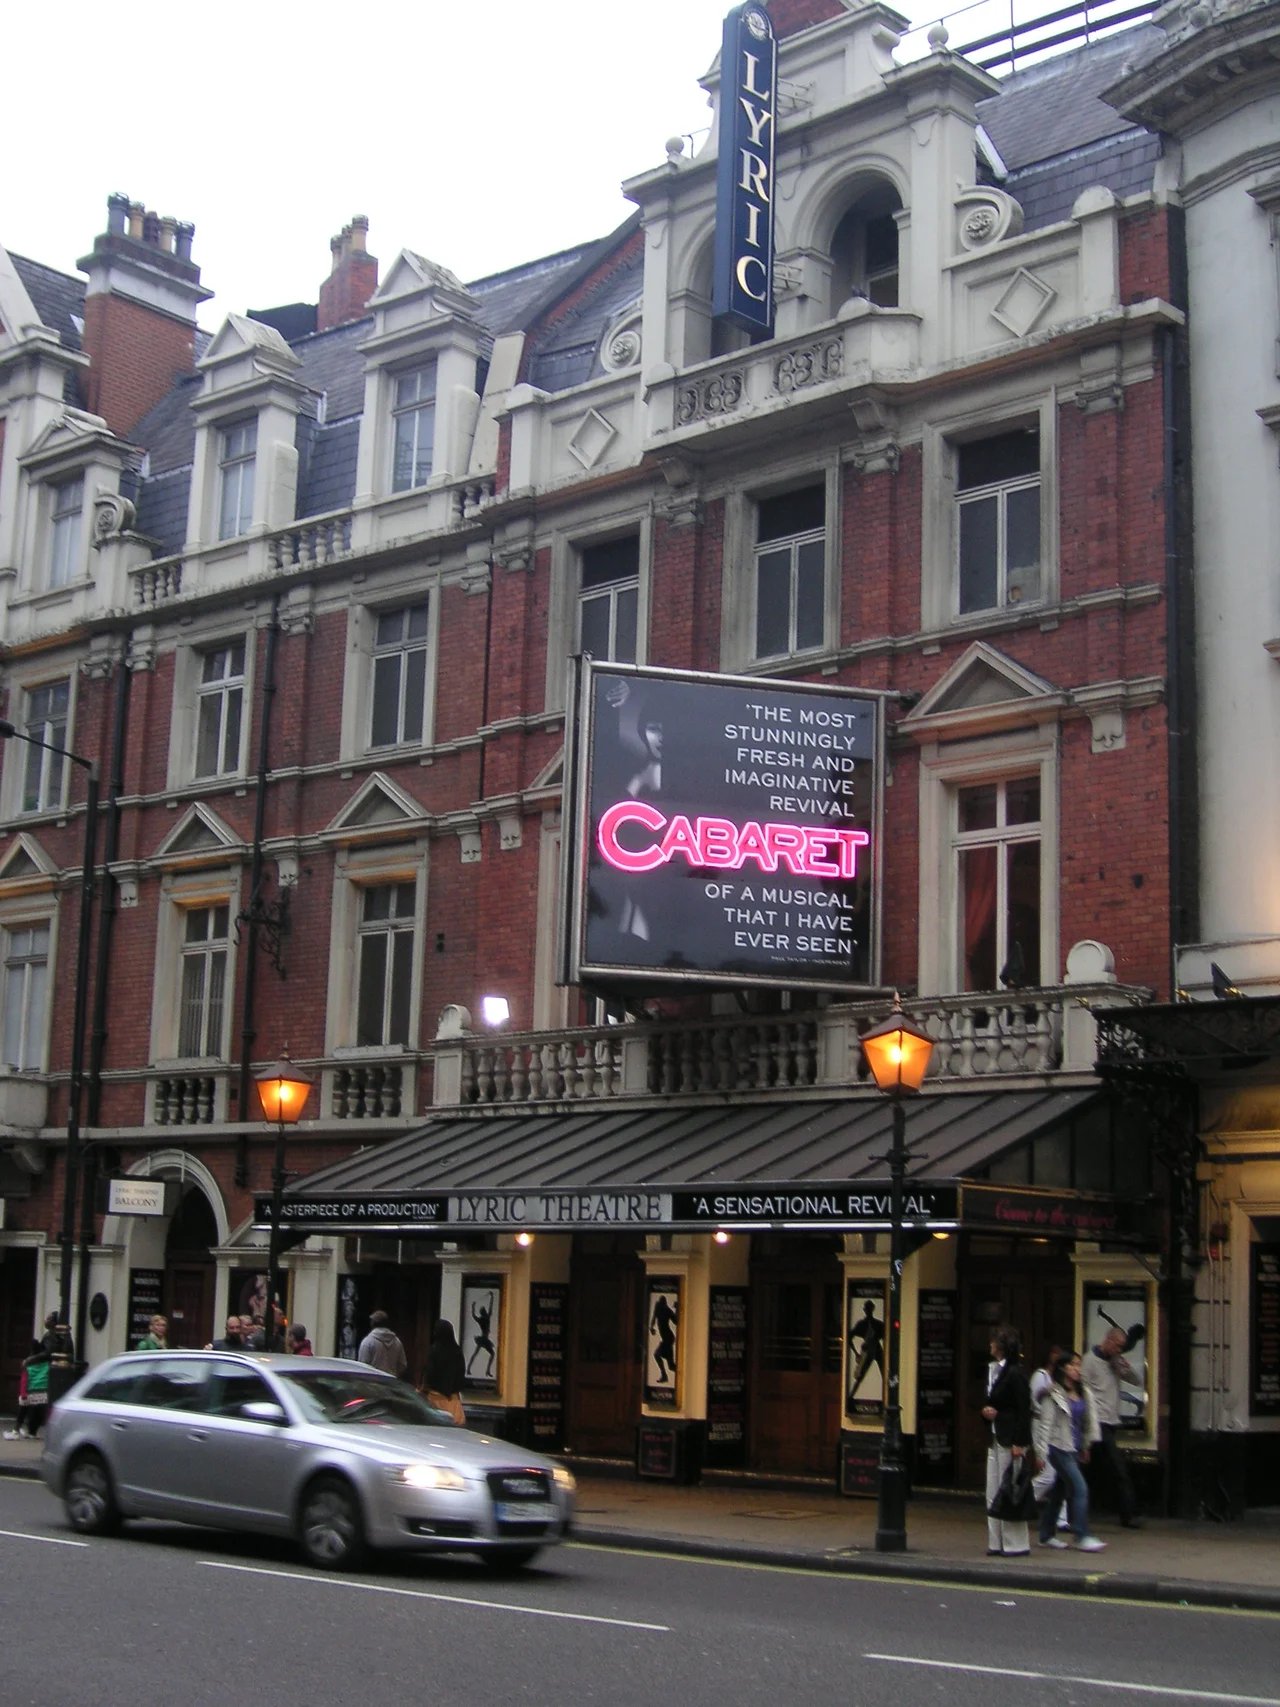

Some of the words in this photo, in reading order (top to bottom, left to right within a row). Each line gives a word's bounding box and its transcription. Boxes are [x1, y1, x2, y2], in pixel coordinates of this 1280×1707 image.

[736, 50, 772, 302] LYRIC
[799, 709, 856, 729] MOST
[724, 724, 856, 751] STUNNINGLY
[736, 748, 805, 768] FRESH
[811, 754, 855, 773] AND
[724, 769, 855, 795] IMAGINATIVE
[769, 796, 855, 818] REVIVAL
[598, 799, 870, 879] CABARET
[704, 883, 735, 900] OF
[740, 886, 756, 902] A
[762, 886, 854, 909] MUSICAL
[723, 907, 778, 927] THAT
[785, 911, 790, 927] I
[797, 913, 853, 932] HAVE
[734, 931, 789, 950] EVER
[115, 1197, 158, 1207] BALCONY
[280, 1204, 340, 1216] ASTERPIECE
[341, 1204, 355, 1216] OF
[358, 1204, 365, 1216] A
[456, 1197, 527, 1222] LYRIC
[539, 1195, 662, 1221] THEATRE
[713, 1195, 844, 1215] SENSATIONAL
